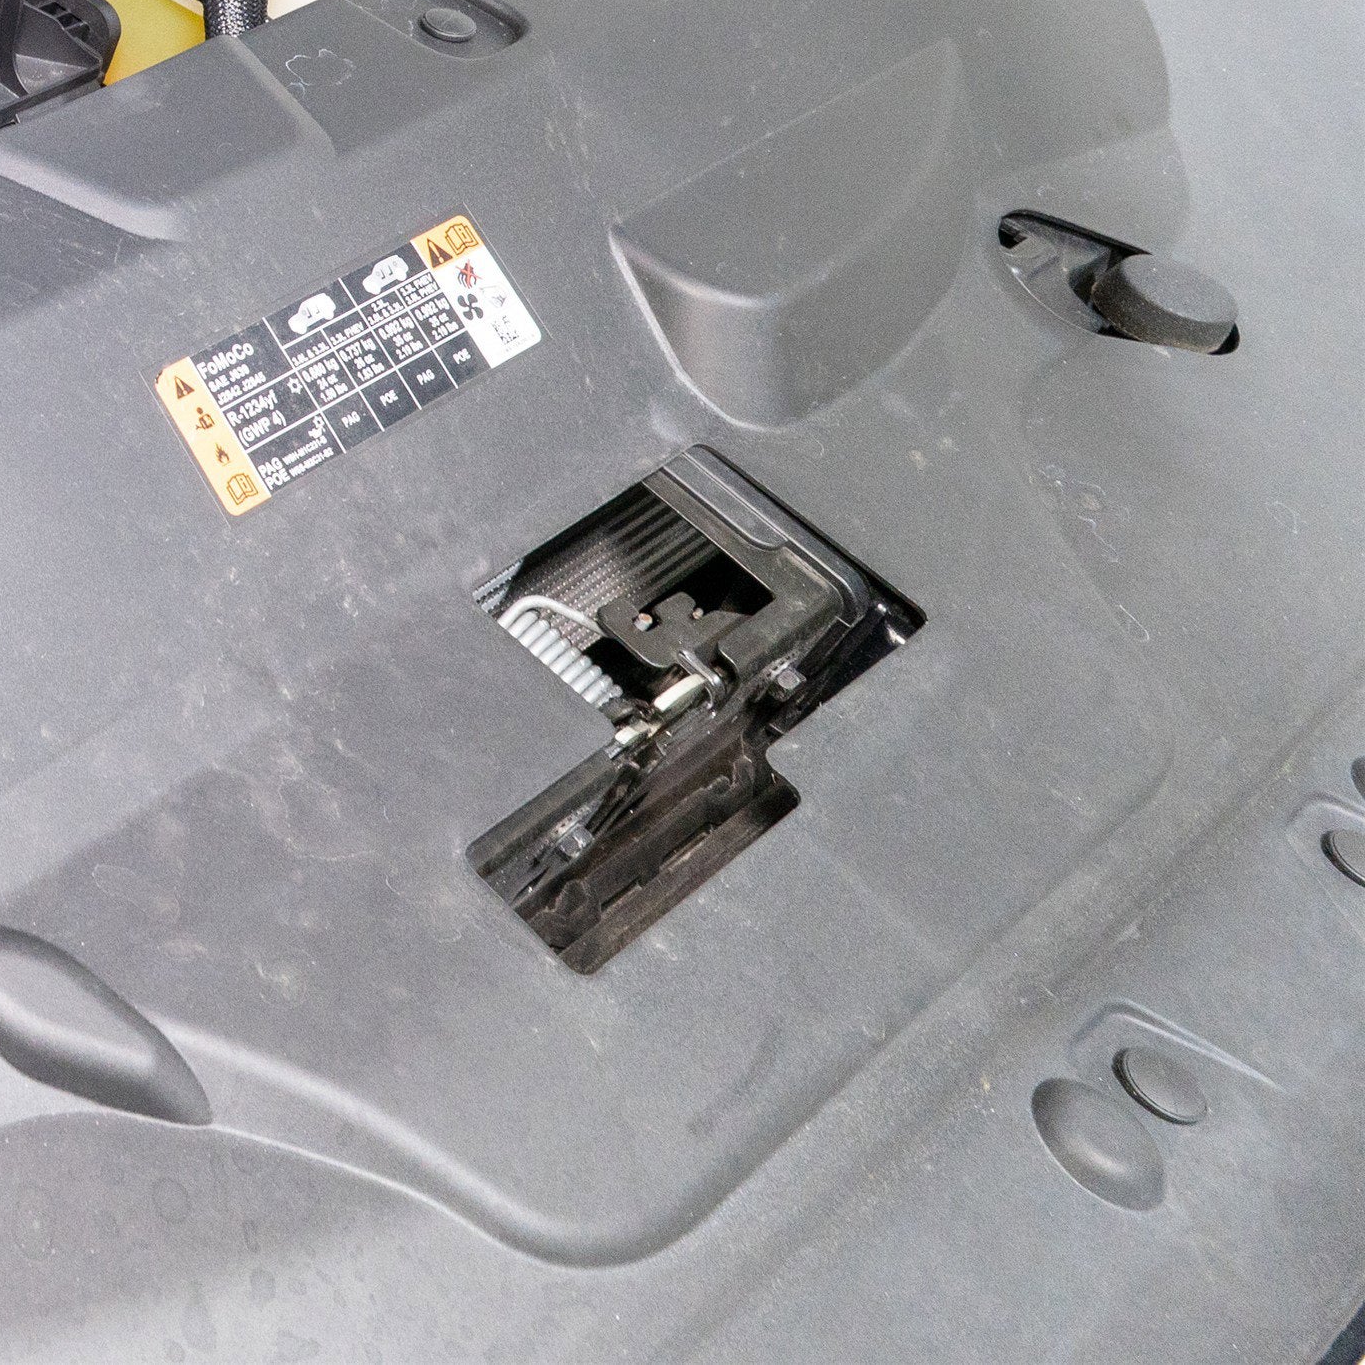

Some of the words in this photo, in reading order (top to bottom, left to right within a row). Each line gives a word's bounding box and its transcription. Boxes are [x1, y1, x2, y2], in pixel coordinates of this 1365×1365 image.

[433, 294, 451, 313] kg
[397, 313, 415, 332] kg
[437, 311, 449, 323] oz
[444, 318, 459, 333] lbs
[401, 330, 414, 342] oz
[408, 337, 424, 352] lbs
[338, 341, 364, 362] 0.737
[359, 334, 377, 353] kg
[451, 347, 471, 364] POE
[195, 337, 256, 380] FoMoCo
[322, 355, 340, 374] kg
[362, 352, 375, 364] oz
[370, 359, 385, 374] lbs
[207, 373, 230, 393] SAE
[325, 372, 338, 385] oz
[415, 367, 436, 385] PAG
[378, 388, 399, 407] POE
[225, 388, 281, 430] R-1234yf
[236, 415, 275, 448] (GWP
[268, 408, 288, 430] 4)
[340, 410, 361, 428] PAG
[256, 455, 283, 479] PAG
[263, 467, 290, 490] POE
